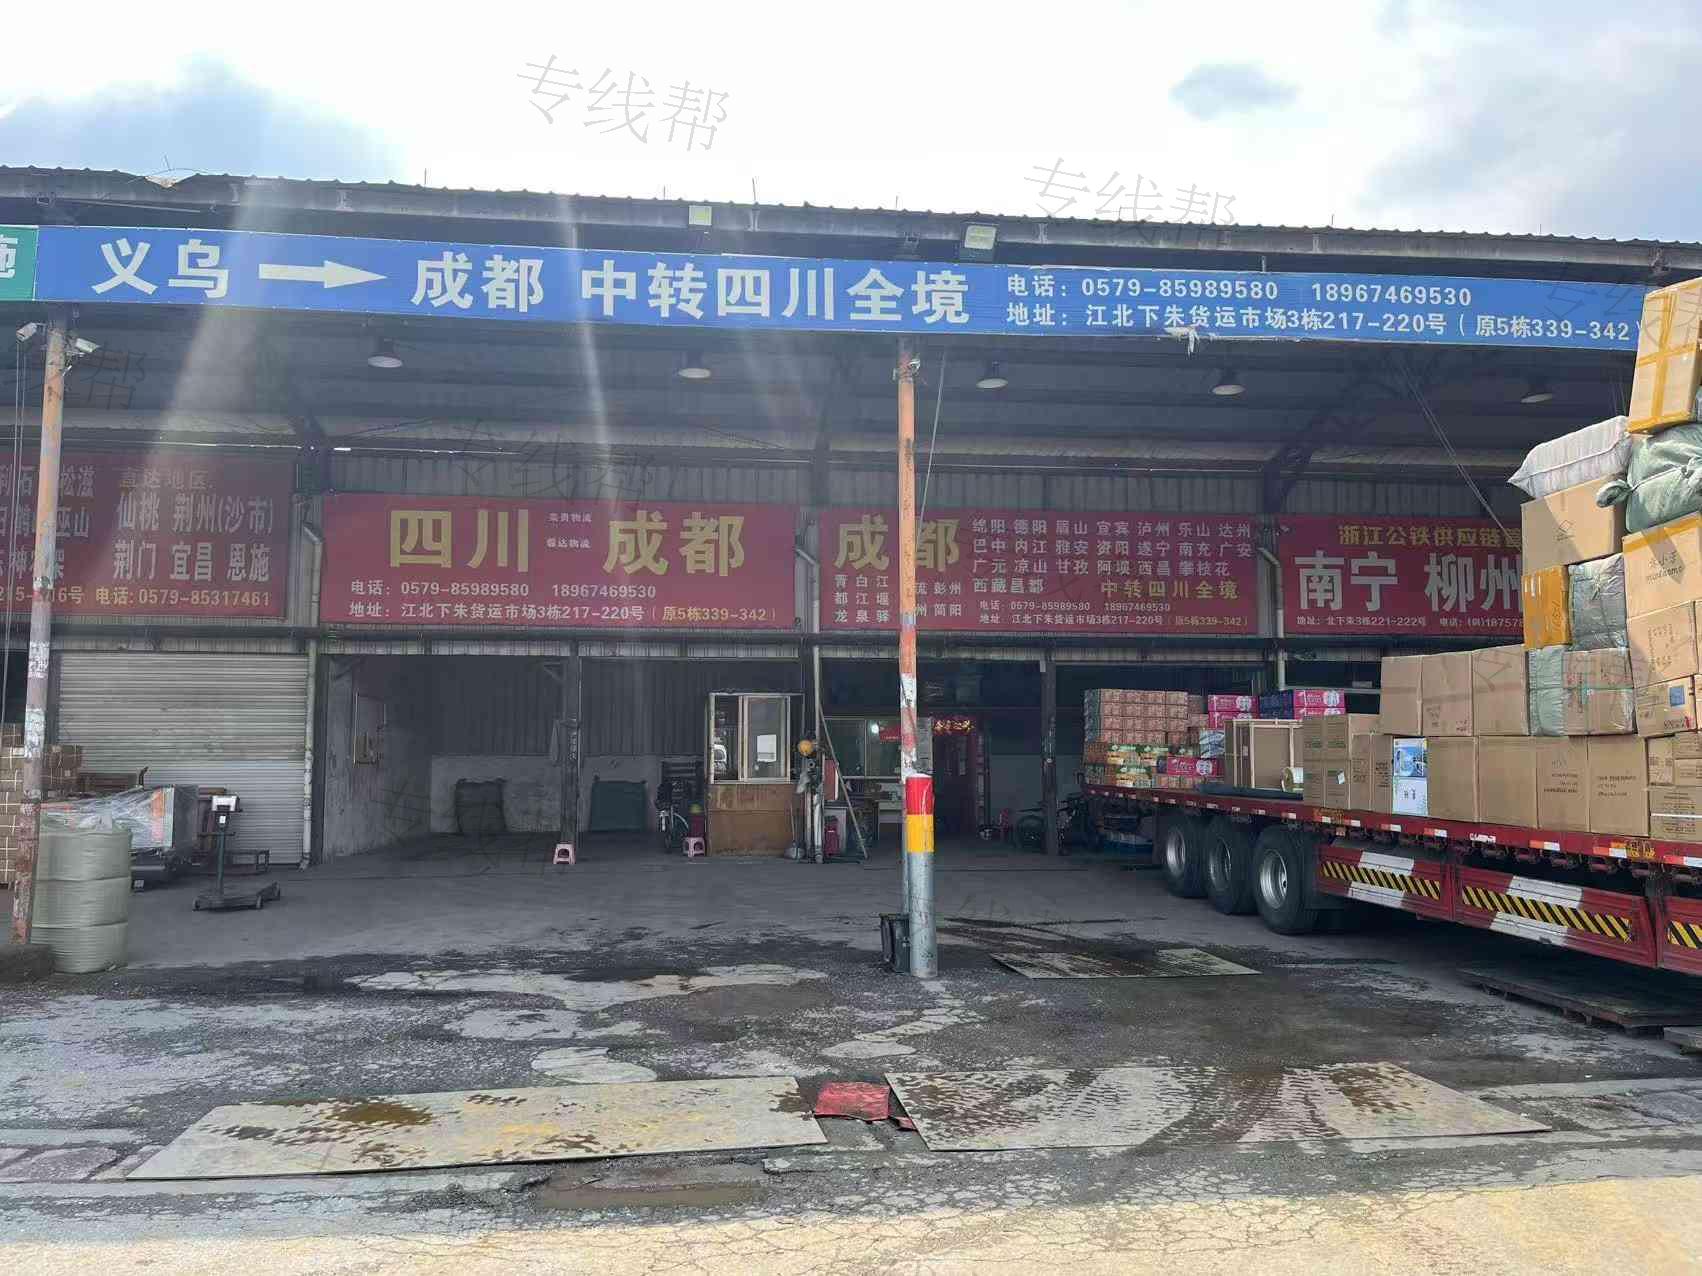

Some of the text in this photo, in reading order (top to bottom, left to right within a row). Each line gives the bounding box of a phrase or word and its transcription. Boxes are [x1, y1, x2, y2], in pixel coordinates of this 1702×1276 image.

[91, 237, 229, 298] 义乌
[410, 251, 545, 312] 成都
[580, 258, 971, 325] 中转四川全境
[1312, 282, 1471, 306] 18967469530
[117, 493, 160, 531] 仙桃
[1137, 521, 1169, 538] 泸州
[1178, 521, 1210, 538] 乐山
[1218, 522, 1251, 539] 达州
[389, 509, 745, 577] 四川 成都
[833, 514, 961, 573] 成都
[973, 539, 1253, 558] 巴中 内江 雅安 资阳 遂宁 南充 广安
[113, 540, 270, 582] 荆门 宜昌 恩施
[972, 559, 1007, 575] 广元
[1014, 558, 1047, 575] 凉山
[1056, 559, 1089, 576] 甘孜
[1097, 560, 1130, 577] 阿坝
[1138, 560, 1170, 577] 西昌
[552, 583, 657, 600] 18967469530
[1100, 580, 1239, 600] 中转四川全境
[1294, 550, 1522, 613] 南宁 柳州
[834, 592, 889, 606] 都江堰
